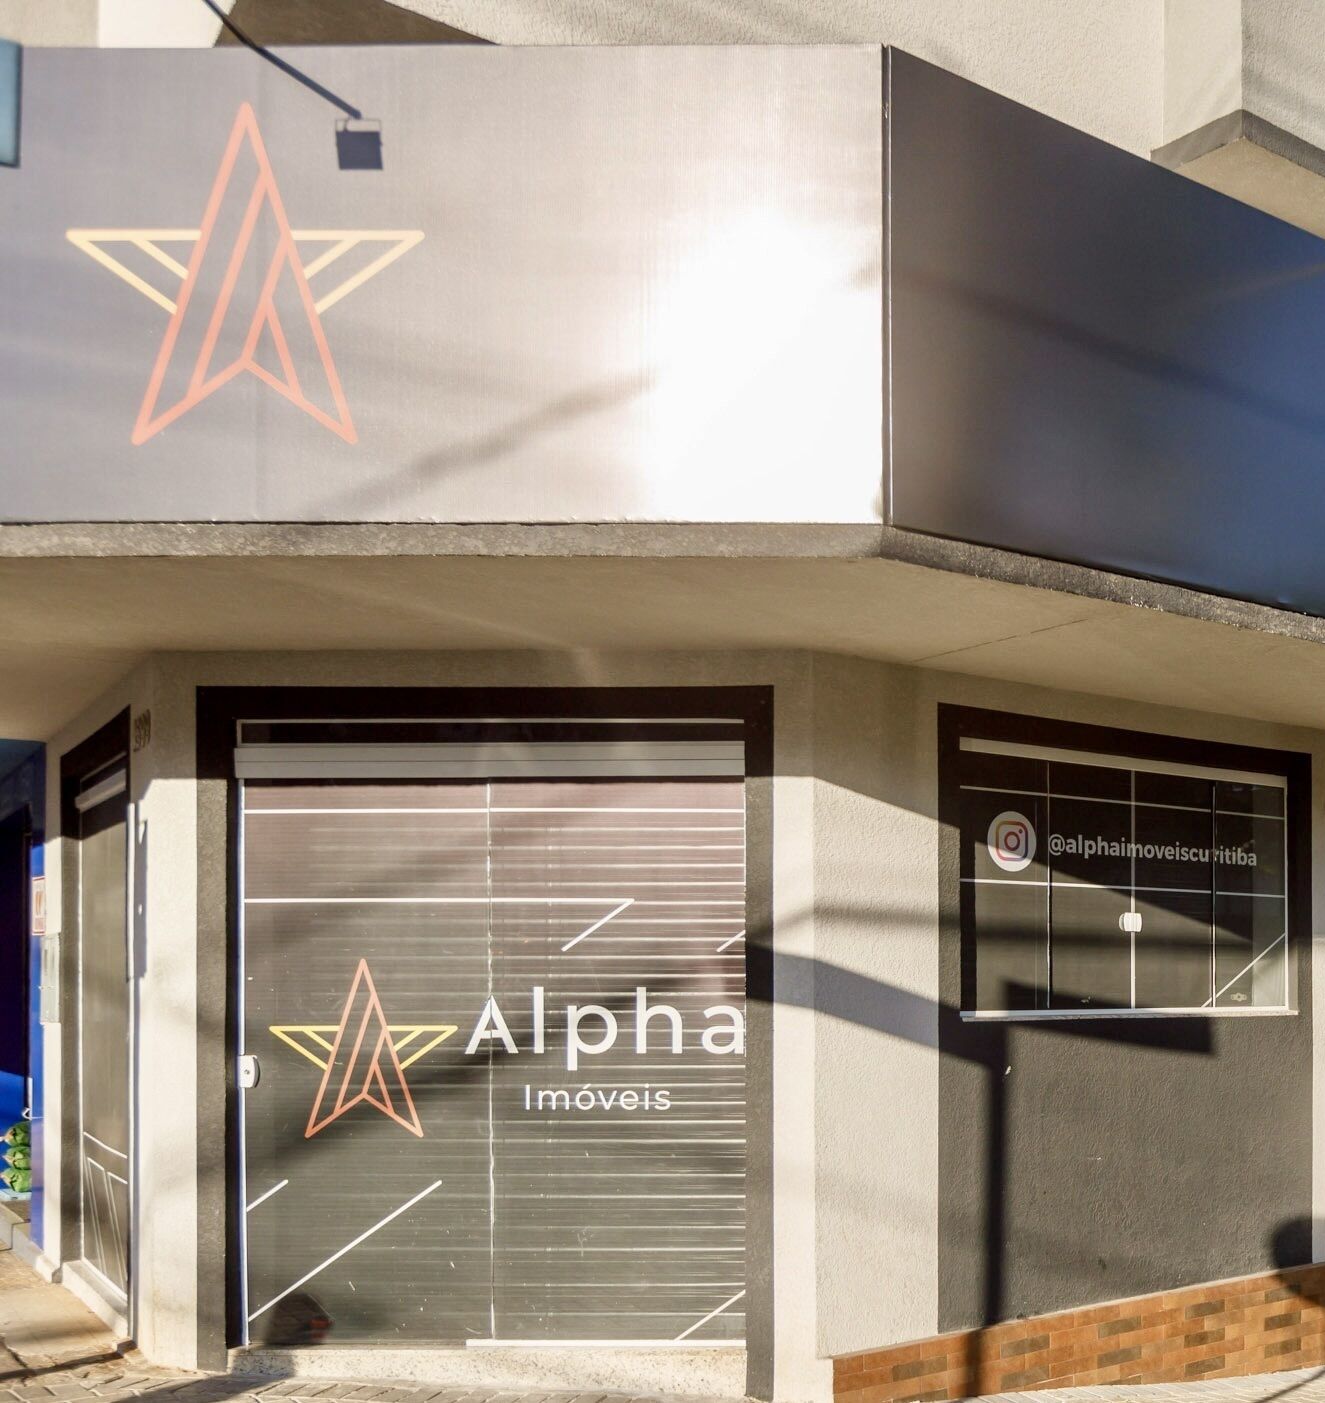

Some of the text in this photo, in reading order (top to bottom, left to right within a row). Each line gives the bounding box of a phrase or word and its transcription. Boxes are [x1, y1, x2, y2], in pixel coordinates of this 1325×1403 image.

[1049, 833, 1257, 867] @alphaimoveiscuritiba
[464, 986, 744, 1071] Alpha
[524, 1083, 671, 1111] Imóveis
